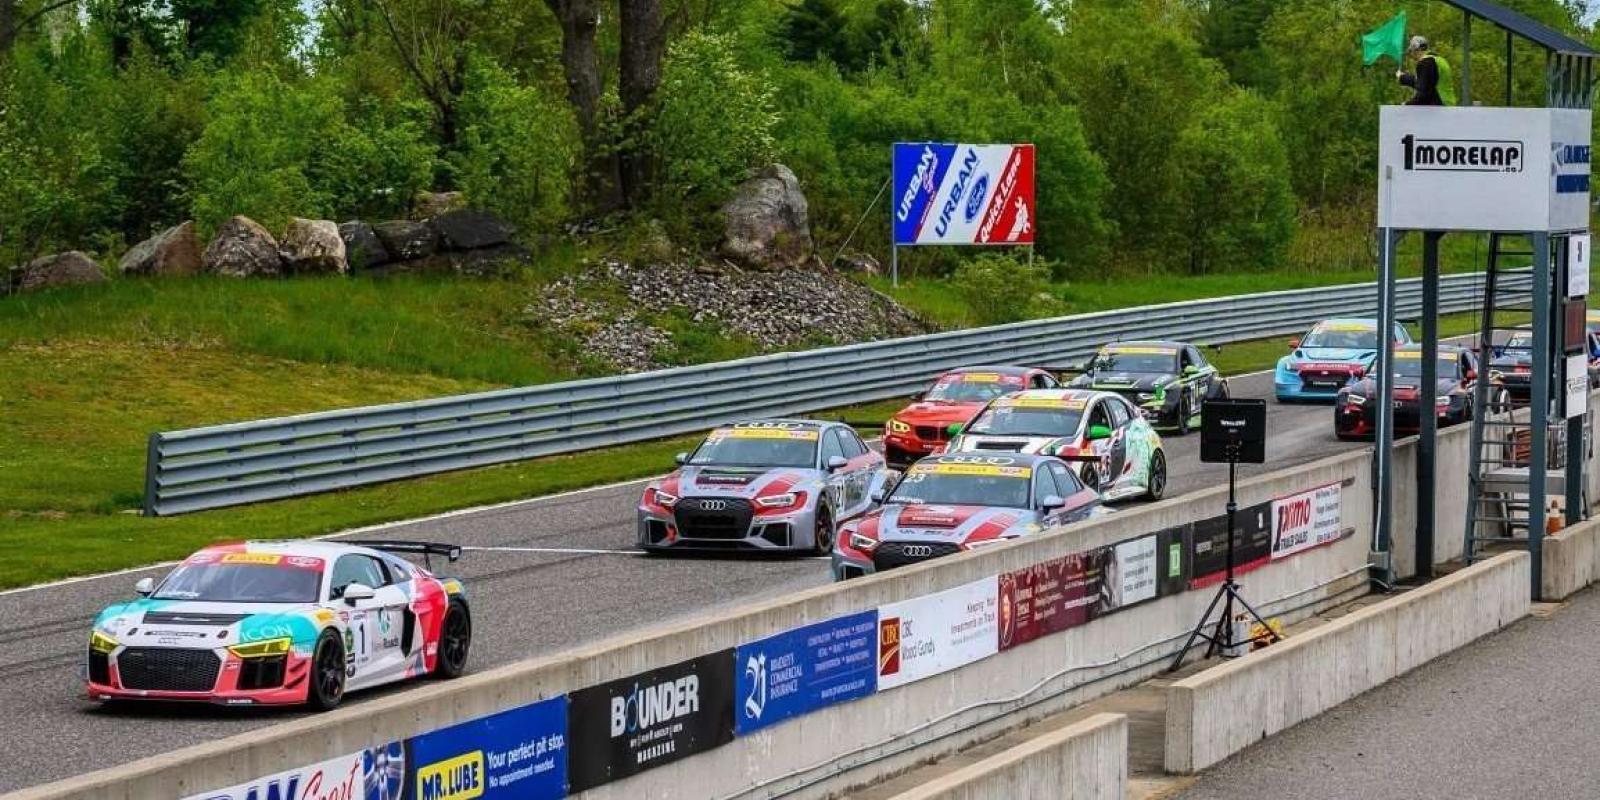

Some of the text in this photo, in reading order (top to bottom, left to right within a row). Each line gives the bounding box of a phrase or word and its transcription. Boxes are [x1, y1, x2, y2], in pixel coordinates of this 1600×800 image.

[897, 145, 934, 222] URBAN
[935, 147, 978, 238] URBAN
[981, 150, 1022, 243] Quick Lane
[904, 473, 925, 483] 23
[242, 624, 292, 641] ICON
[358, 623, 366, 655] 1
[611, 674, 699, 738] BOUNDER
[487, 751, 506, 770] Your
[508, 740, 536, 767] perfect
[536, 737, 547, 756] pit
[449, 761, 479, 796] LUBE
[489, 775, 499, 788] No
[499, 764, 534, 786] appointment
